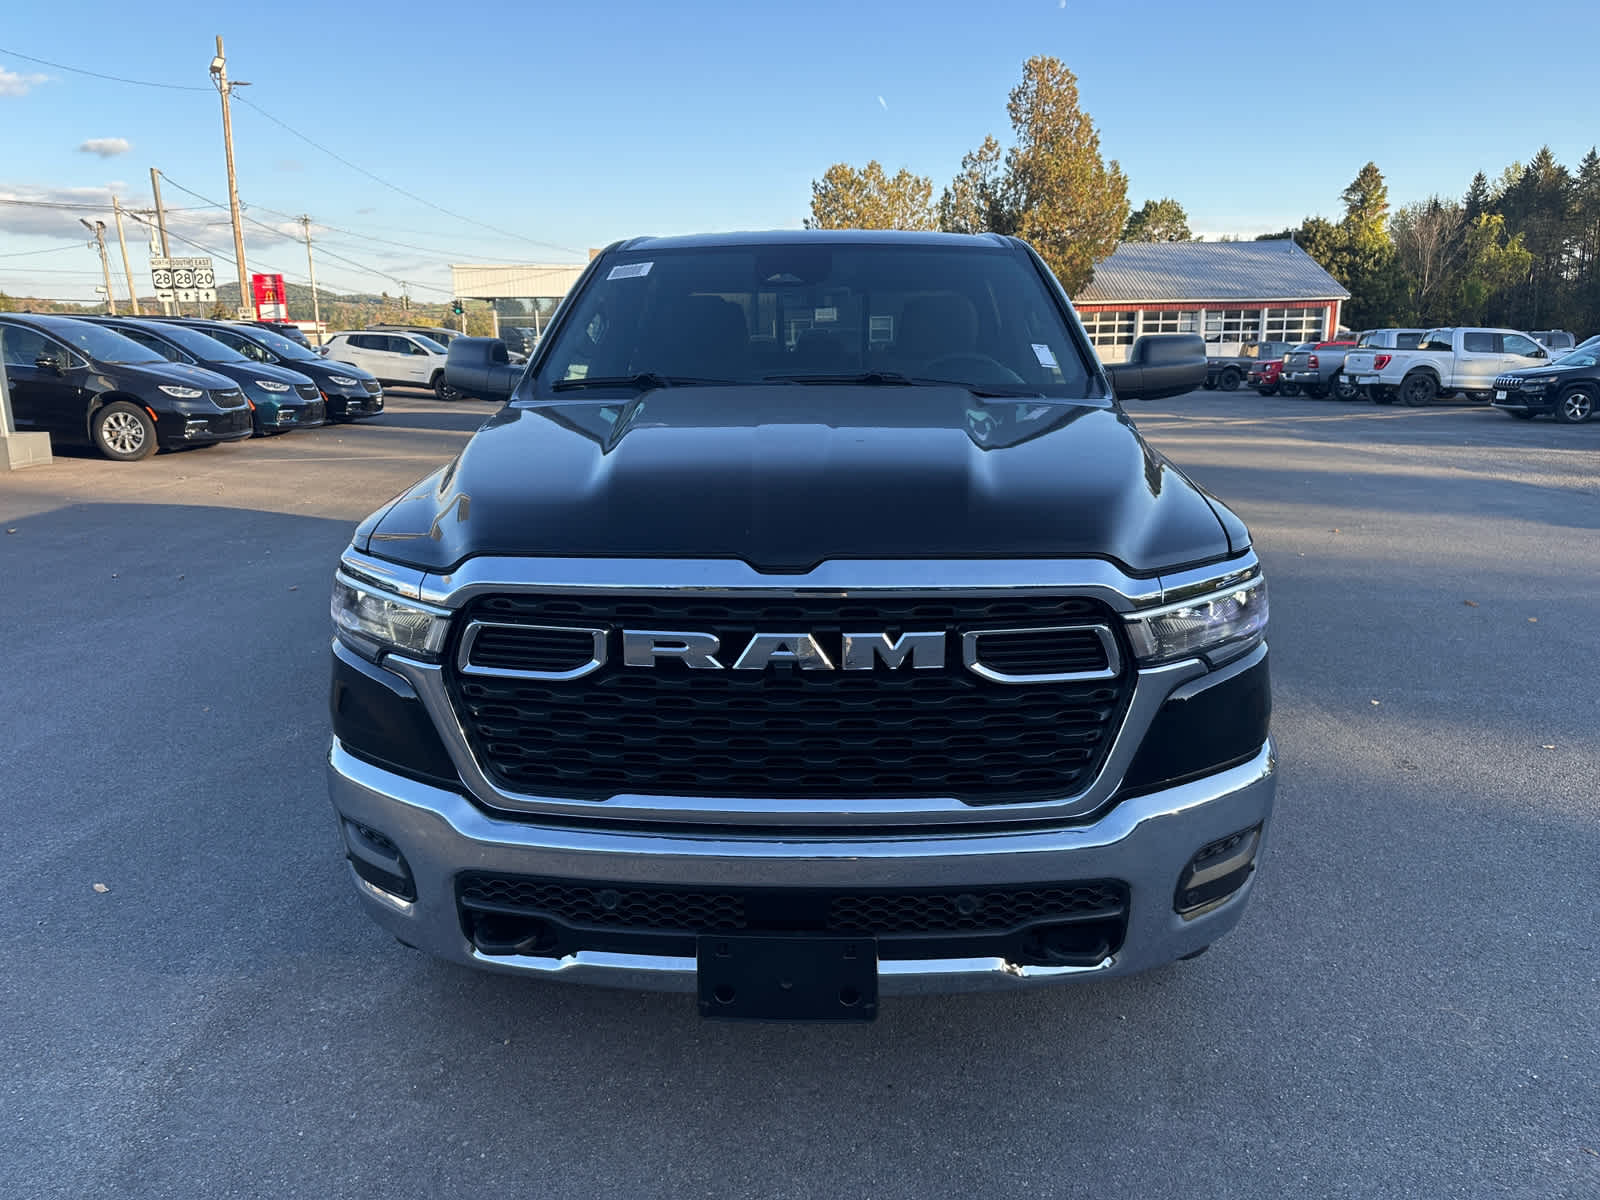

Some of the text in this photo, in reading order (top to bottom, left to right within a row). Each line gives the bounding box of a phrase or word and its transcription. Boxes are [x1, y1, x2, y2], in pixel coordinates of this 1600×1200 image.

[155, 273, 171, 284] 28
[175, 273, 191, 284] 28
[196, 273, 213, 284] 20
[622, 629, 947, 670] RAM
